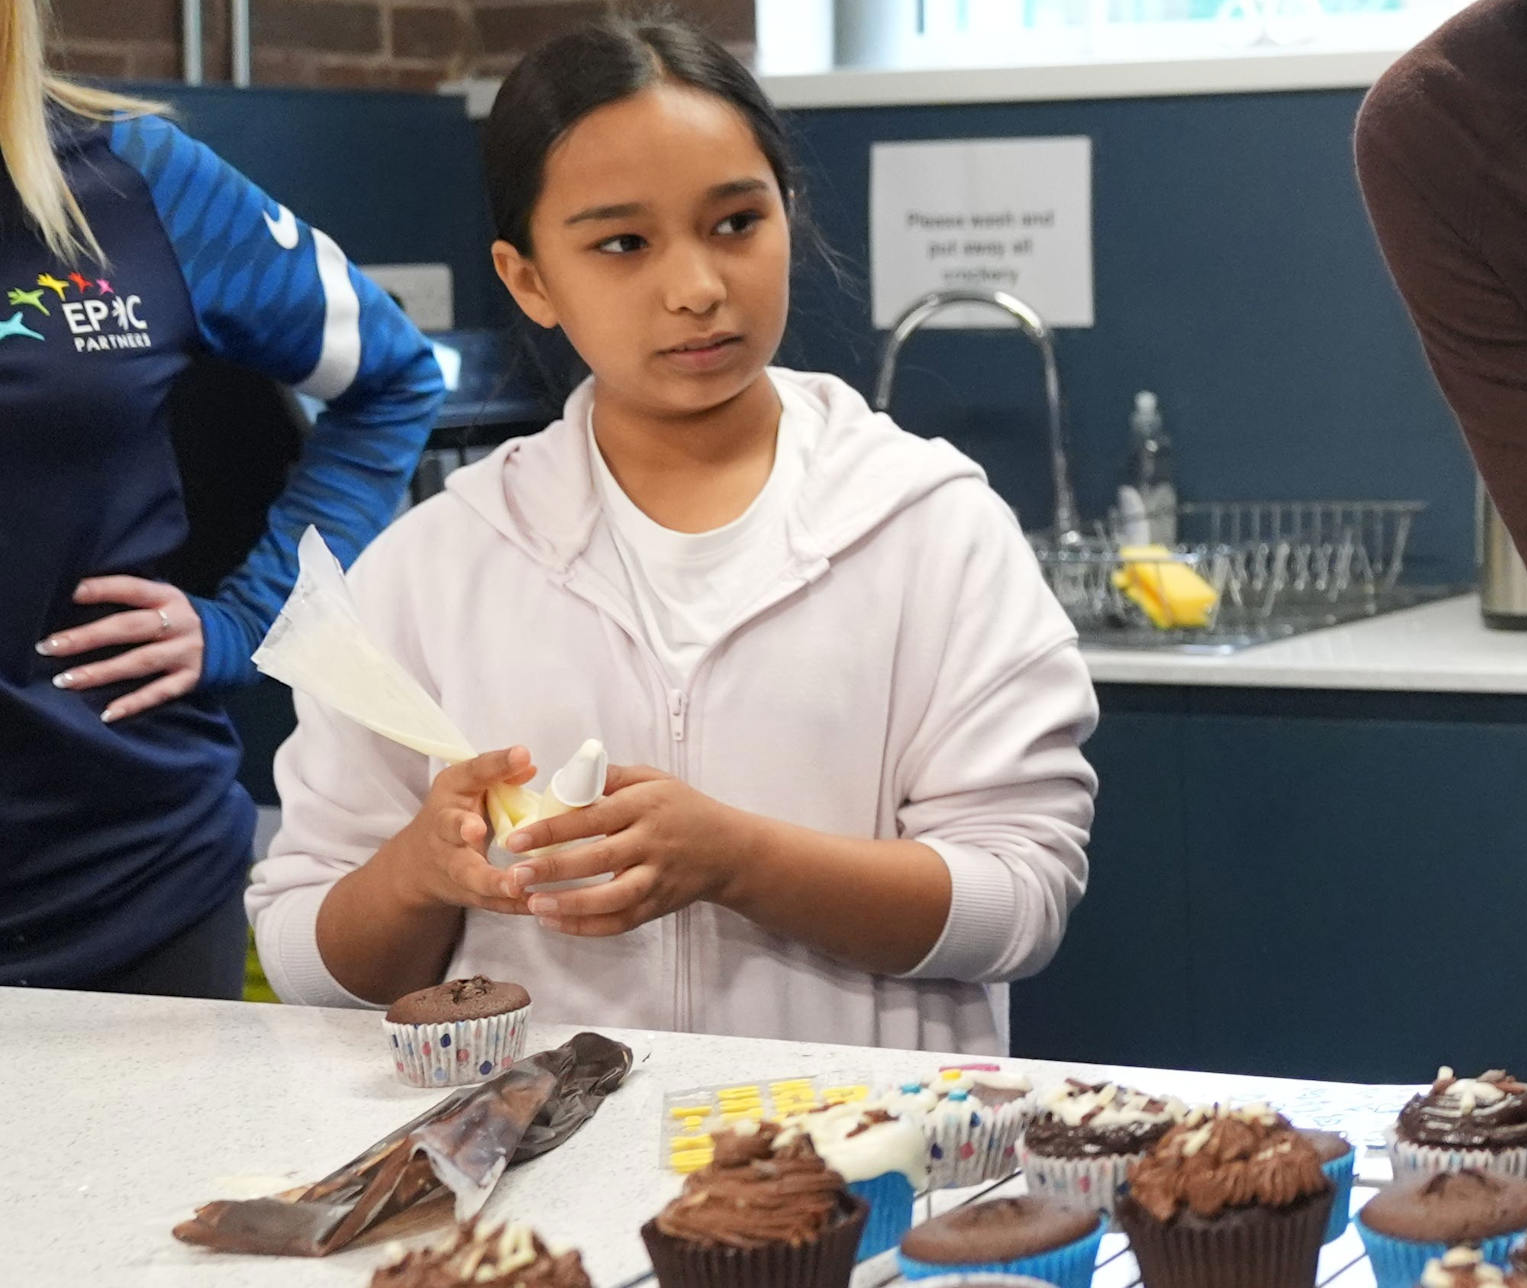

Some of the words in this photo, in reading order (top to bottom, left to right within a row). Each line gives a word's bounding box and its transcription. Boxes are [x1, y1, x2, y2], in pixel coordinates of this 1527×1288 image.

[906, 210, 965, 228] Please
[1022, 209, 1055, 227] and
[74, 332, 152, 353] PARTNERS
